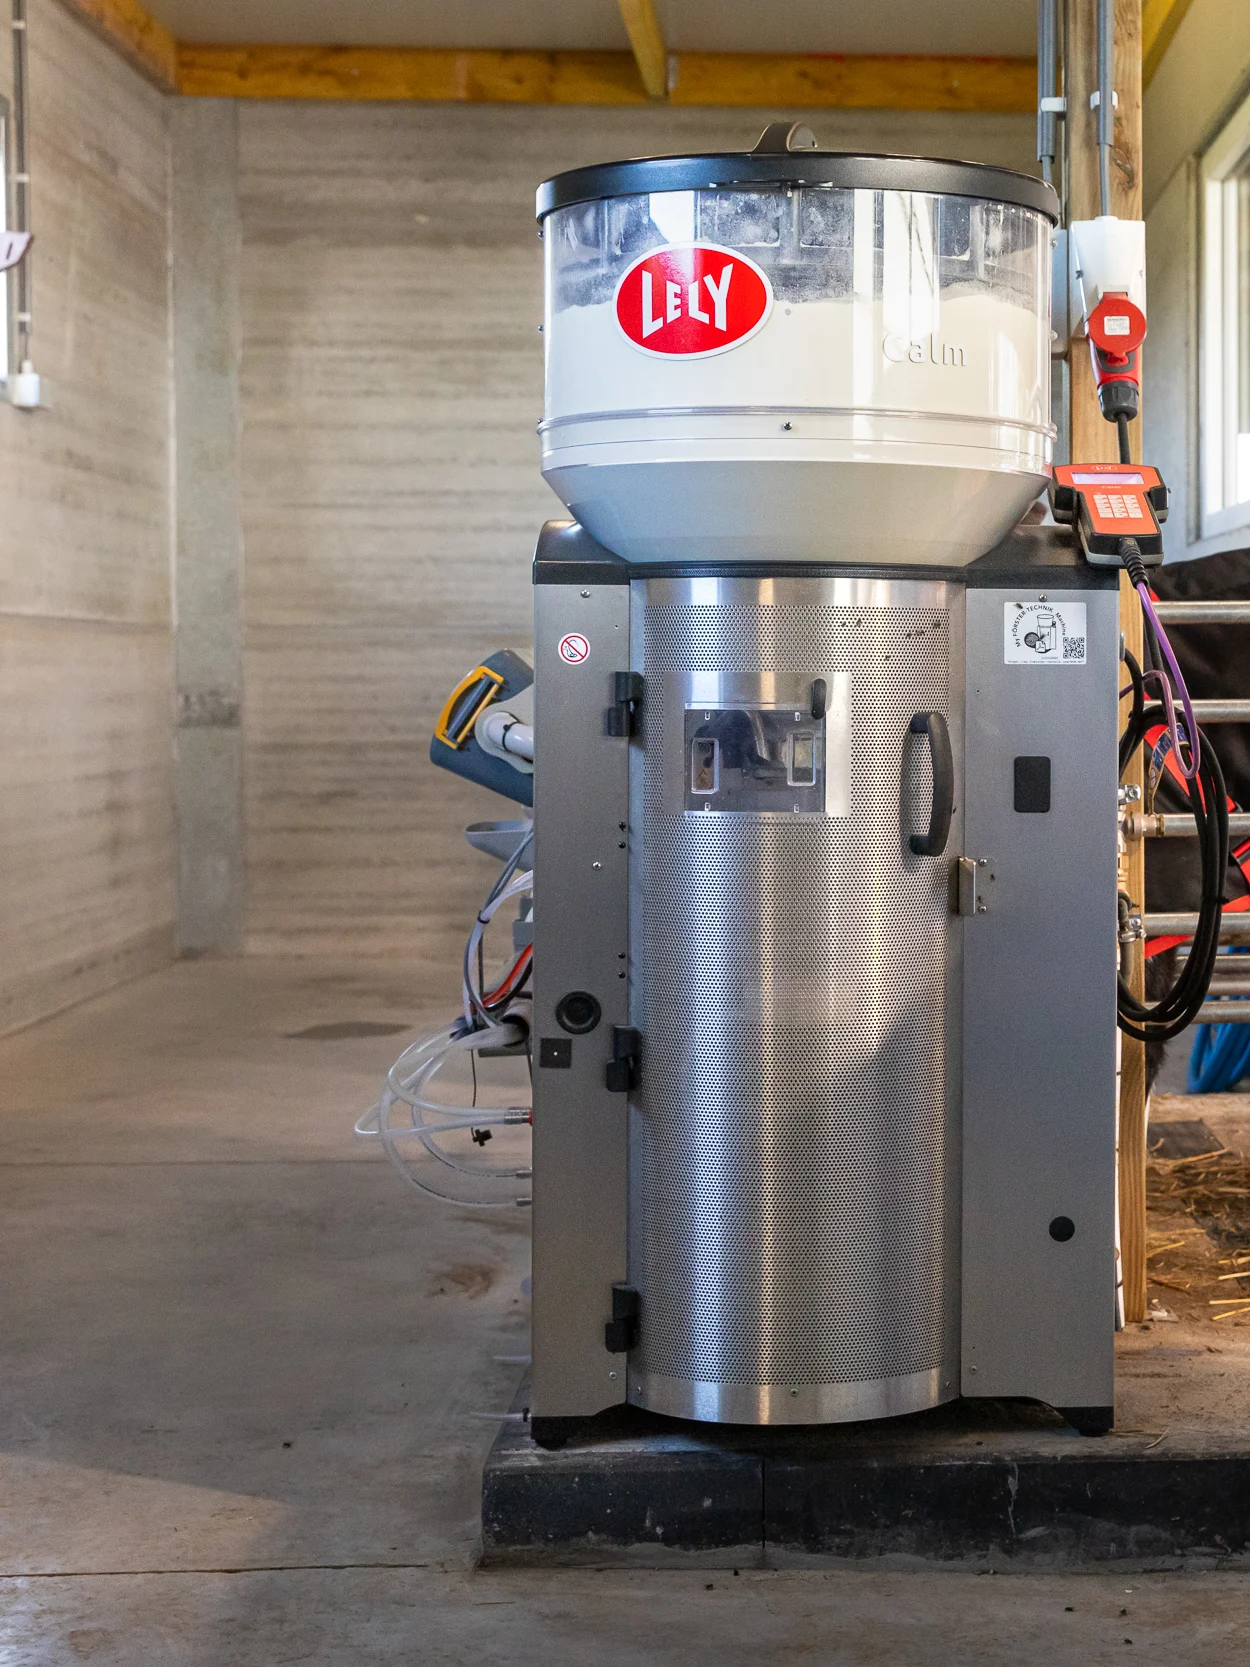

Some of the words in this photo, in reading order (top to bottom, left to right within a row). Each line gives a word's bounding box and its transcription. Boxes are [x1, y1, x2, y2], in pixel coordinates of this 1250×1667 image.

[642, 263, 733, 339] LELY
[882, 331, 968, 367] Calm
[1055, 612, 1067, 636] Machine
